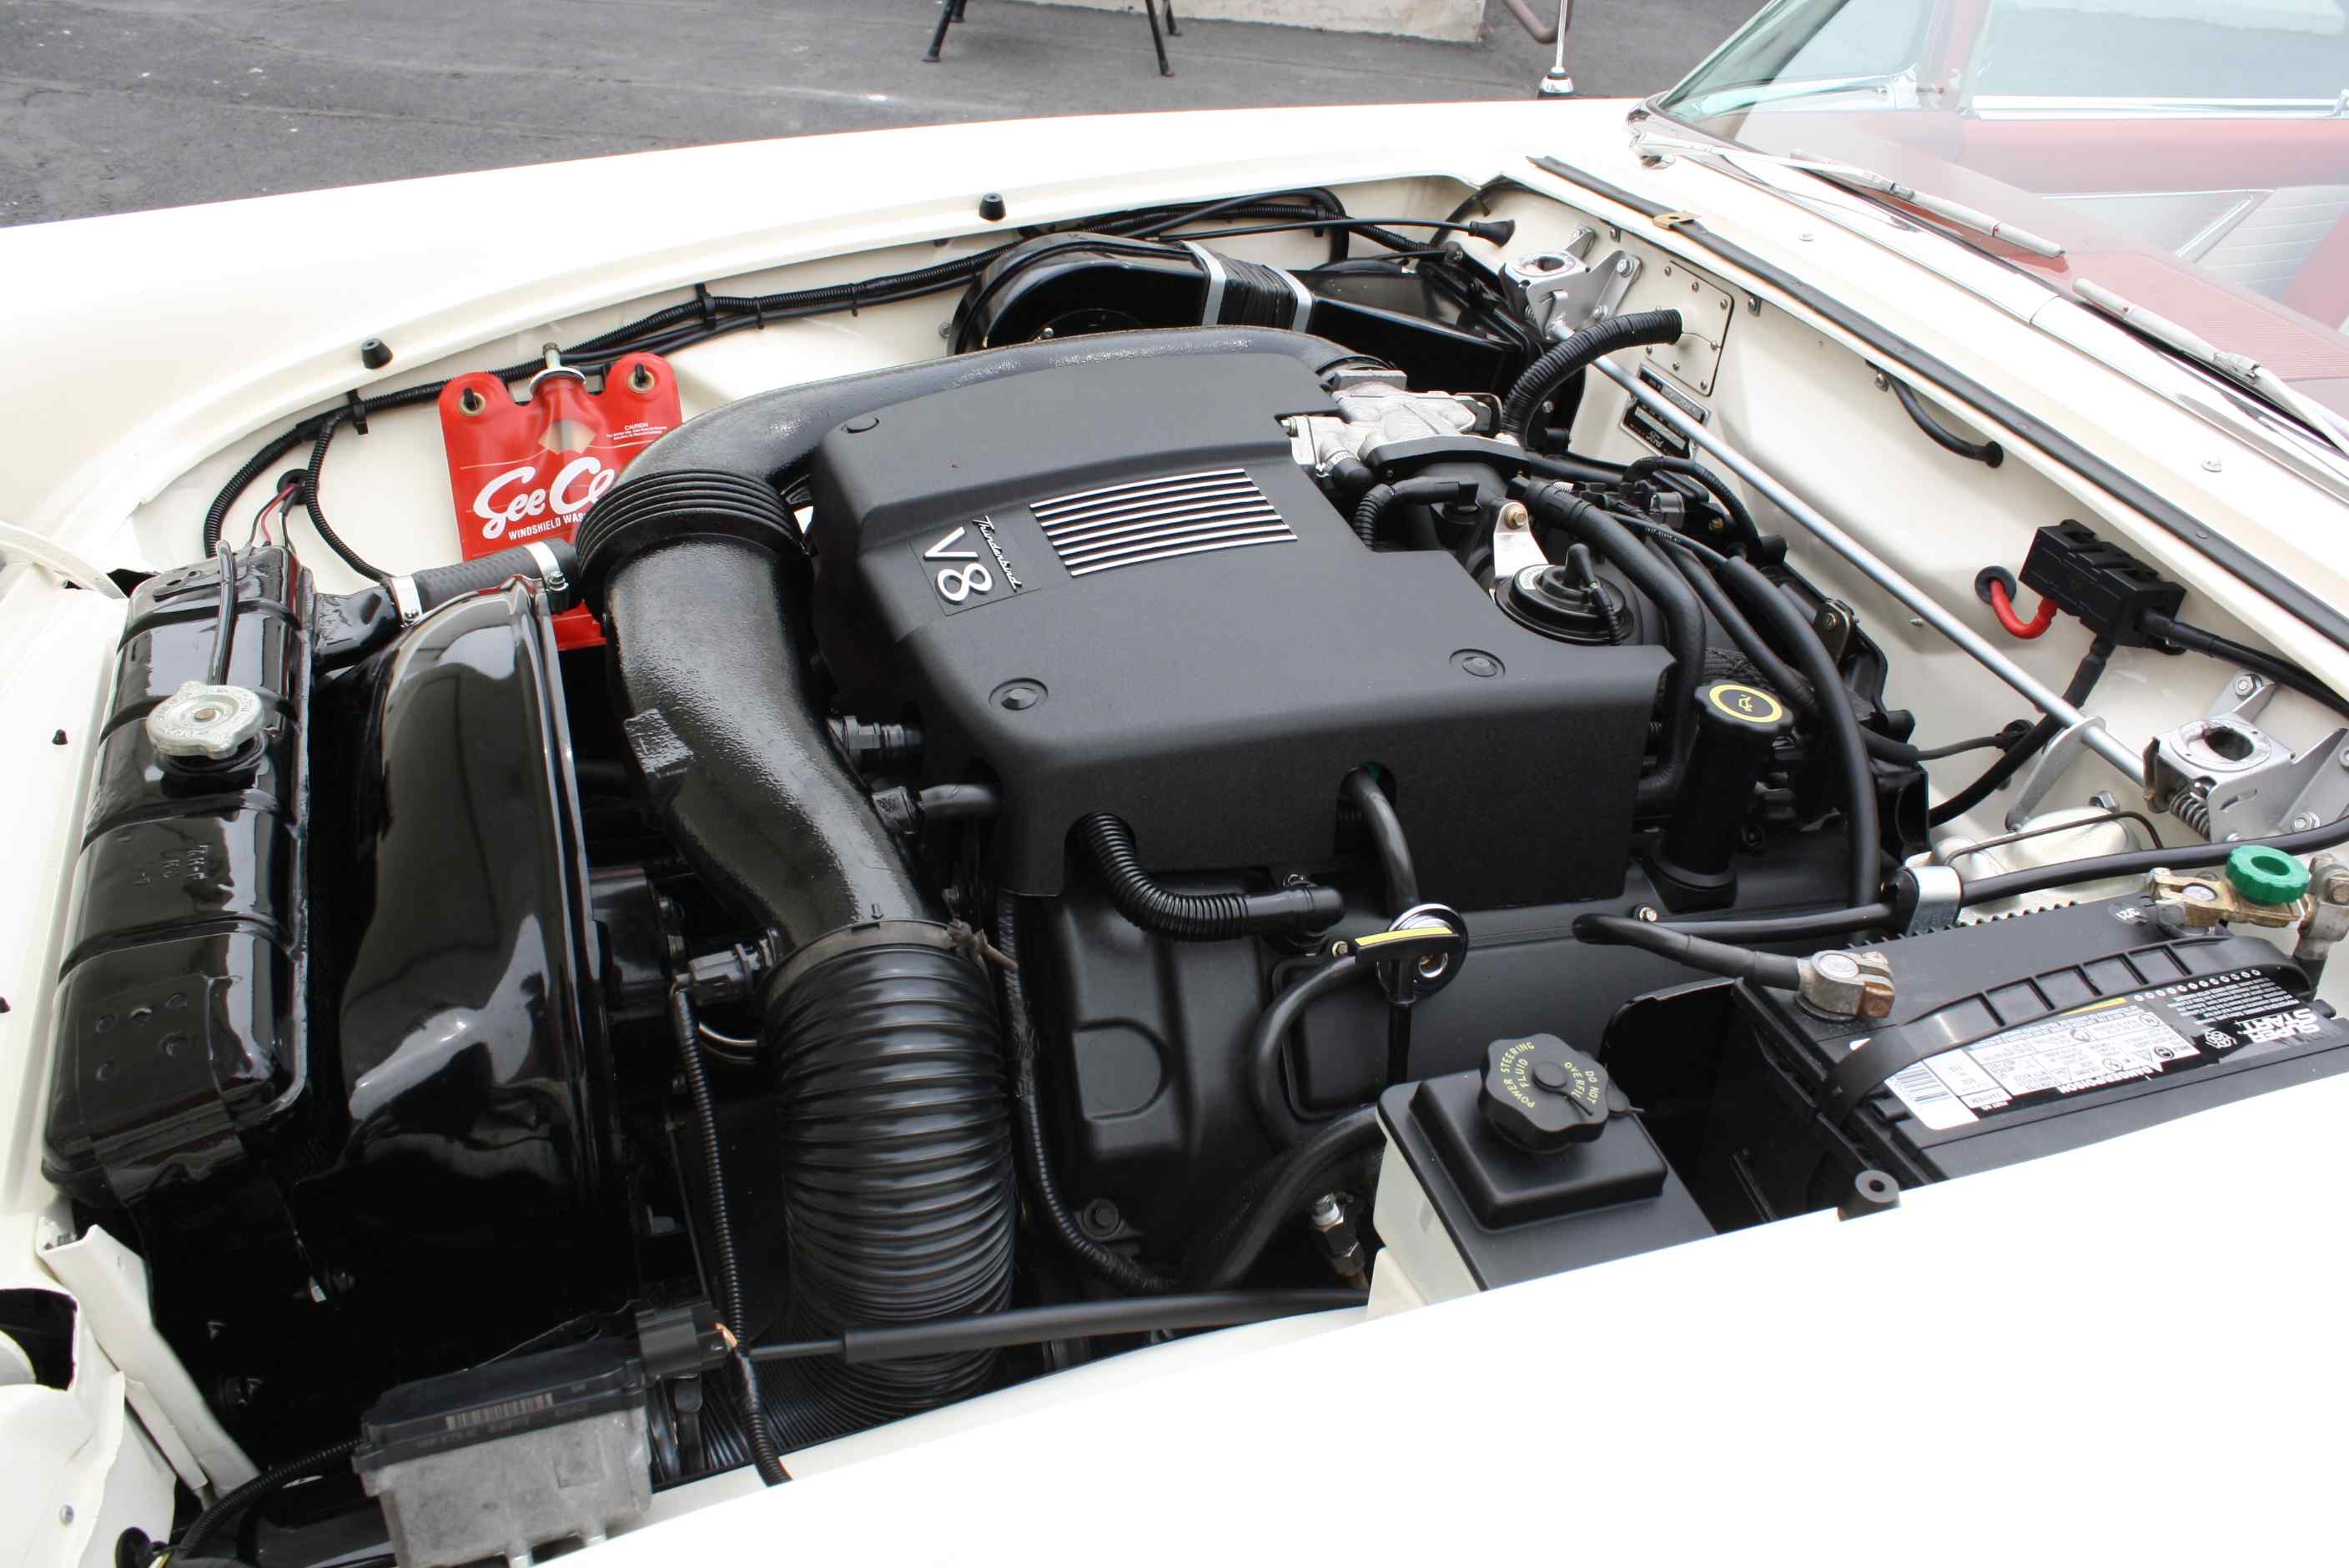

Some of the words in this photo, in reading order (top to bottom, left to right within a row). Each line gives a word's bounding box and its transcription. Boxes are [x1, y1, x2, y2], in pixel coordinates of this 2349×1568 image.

[508, 517, 561, 540] WINDSHIELD
[563, 512, 586, 525] WAS
[924, 526, 993, 603] V8
[972, 515, 1022, 592] Thunderbird
[2242, 1008, 2318, 1033] START
[2247, 1023, 2320, 1043] SUPER
[1501, 1042, 1536, 1073] STEERING
[1515, 1058, 1531, 1088] FLUID
[1585, 1070, 1597, 1083] DO
[1503, 1078, 1536, 1108] POWER
[1587, 1088, 1600, 1104] NOT
